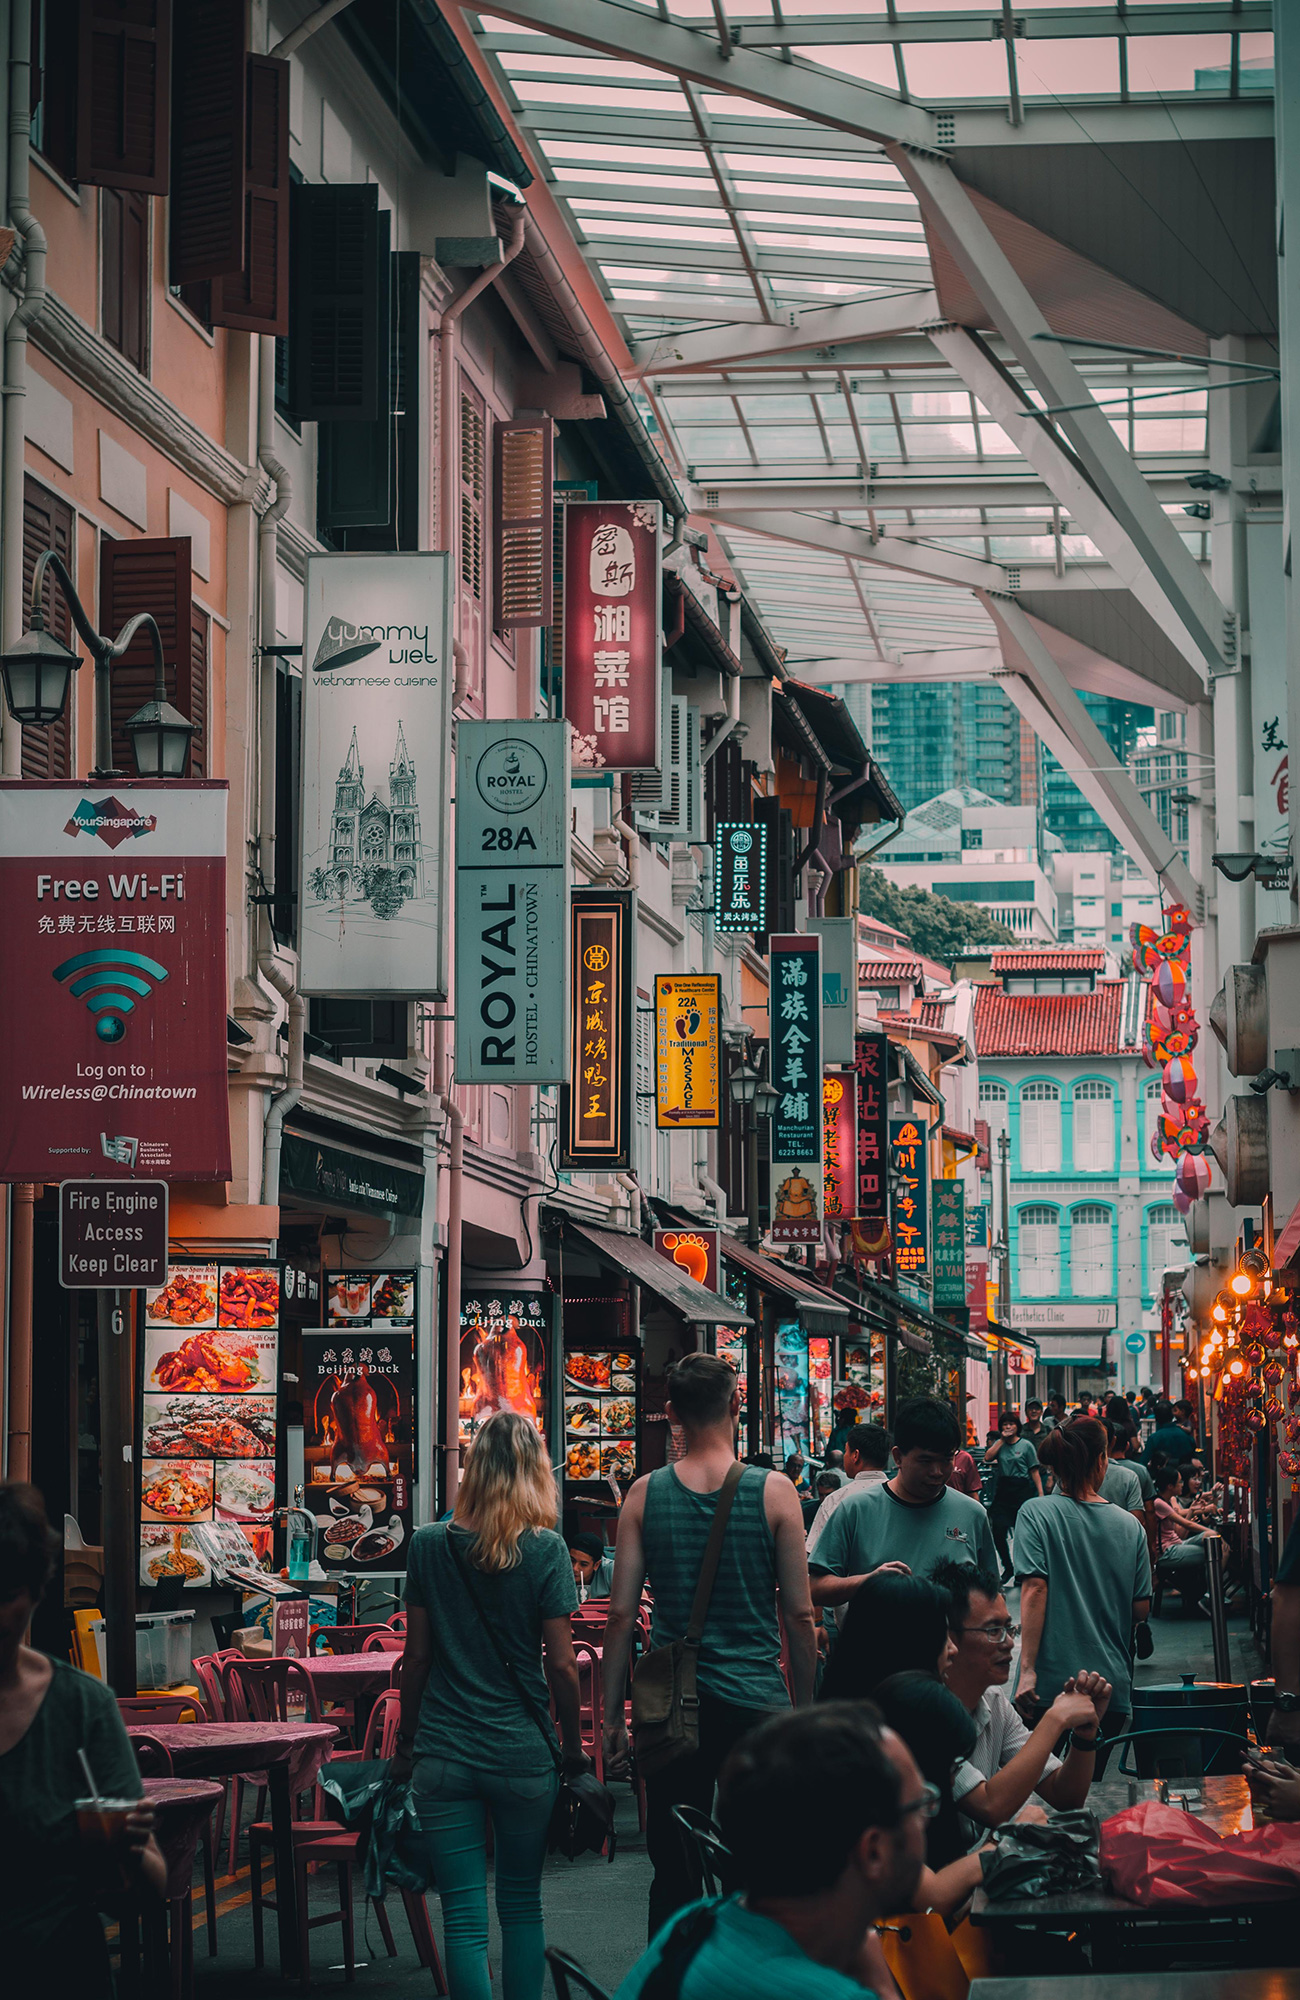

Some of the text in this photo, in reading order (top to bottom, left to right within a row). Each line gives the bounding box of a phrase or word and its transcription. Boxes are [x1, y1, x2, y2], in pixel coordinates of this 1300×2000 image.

[328, 625, 428, 647] yummy
[389, 649, 438, 664] viet
[593, 605, 631, 733] 湘菜馆
[312, 672, 438, 686] vietnamese cuisine
[487, 776, 535, 788] ROYAL
[72, 816, 153, 829] YourSingapore
[481, 827, 537, 851] 28A
[37, 873, 184, 900] Free Wi-Fi
[38, 915, 175, 934] 免费无线互联网
[480, 884, 516, 1066] ROYAL
[525, 883, 538, 1066] HOSTEL CHINATOWN
[678, 997, 697, 1008] 22A
[77, 1063, 146, 1080] Log on to
[681, 1047, 695, 1109] MASSAGE
[21, 1084, 197, 1101] Wireless@Chinatown
[69, 1192, 158, 1215] Fire Engine
[85, 1223, 144, 1241] Access
[69, 1254, 158, 1277] Keep Clear
[188, 1266, 204, 1274] Spare
[204, 1265, 217, 1273] Ribs
[935, 1265, 944, 1277] CI
[945, 1265, 963, 1277] YAN
[459, 1316, 546, 1328] Beijing Duck
[1012, 1307, 1110, 1324] Aesthetics Clinic 277
[318, 1364, 400, 1375] Beijing Duck
[142, 1525, 161, 1533] Fried
